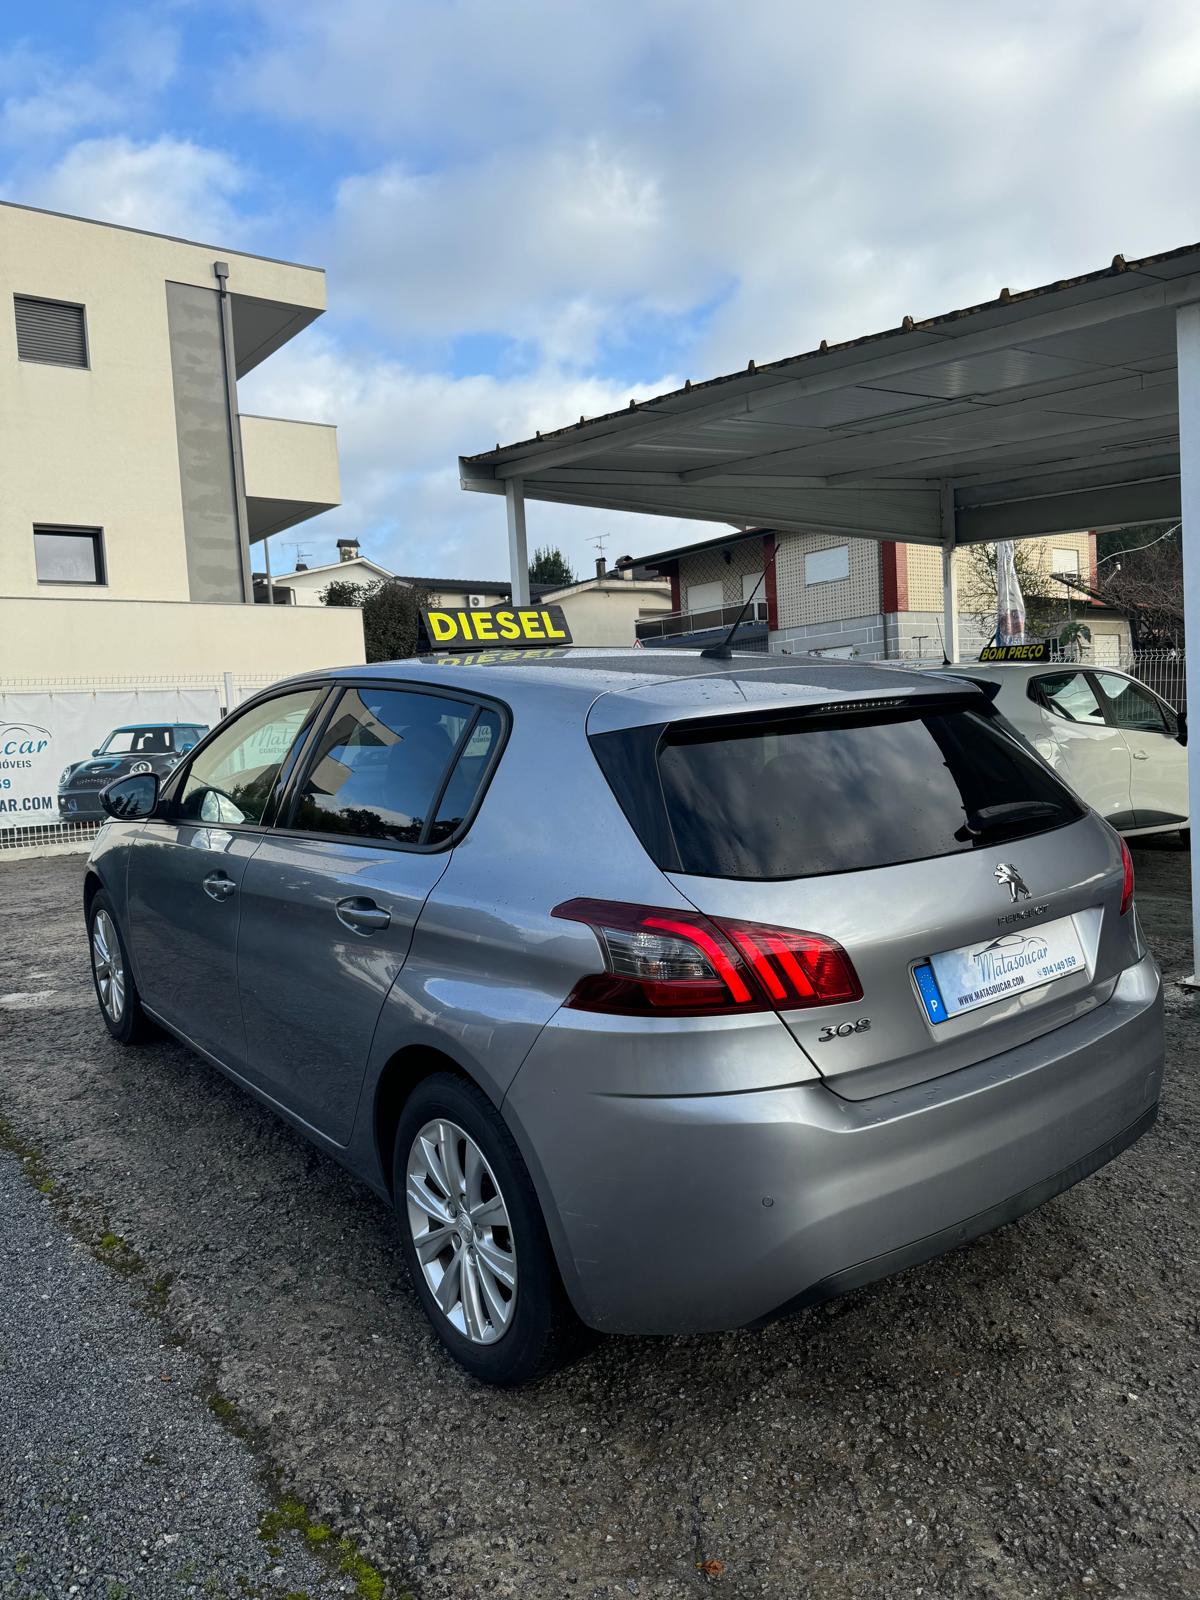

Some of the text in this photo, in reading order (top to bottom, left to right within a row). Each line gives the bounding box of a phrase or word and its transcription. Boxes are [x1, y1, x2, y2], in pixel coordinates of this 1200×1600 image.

[427, 611, 566, 641] DIESEL
[981, 645, 1044, 660] BOM PREÇO
[0, 739, 48, 755] car
[0, 759, 32, 769] ÓVEIS
[975, 946, 1048, 982] Matasoucar
[1042, 965, 1054, 976] 914
[1054, 960, 1066, 972] 149
[958, 976, 1025, 1006] WWW.MATASOUCAR.COM
[930, 999, 938, 1012] P
[818, 1017, 872, 1042] 308
